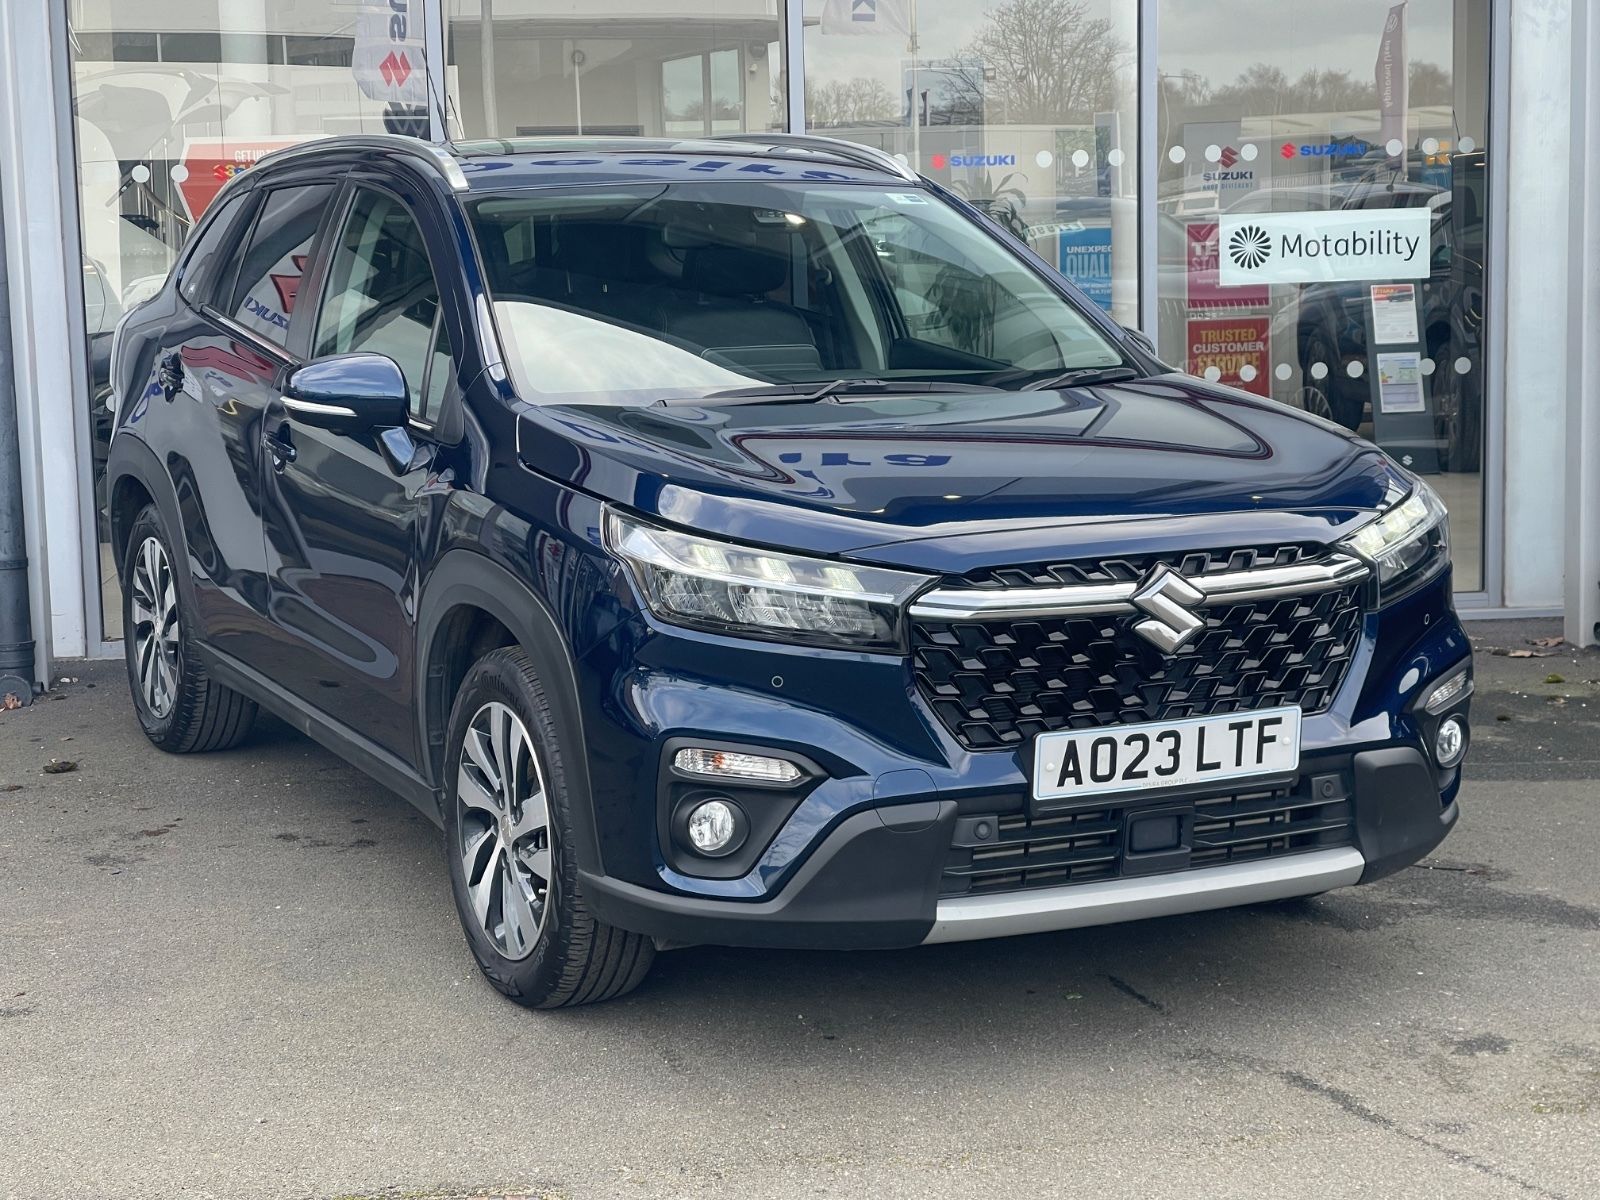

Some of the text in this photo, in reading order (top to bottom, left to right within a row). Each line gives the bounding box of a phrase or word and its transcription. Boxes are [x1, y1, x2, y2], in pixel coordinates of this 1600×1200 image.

[950, 155, 1016, 167] SUZUKI
[1203, 171, 1253, 181] SUZUKI
[1281, 230, 1419, 261] Motability
[1201, 328, 1257, 342] TRUSTED
[1193, 341, 1264, 354] CUSTOMER
[1056, 716, 1283, 788] AO23 LTF
